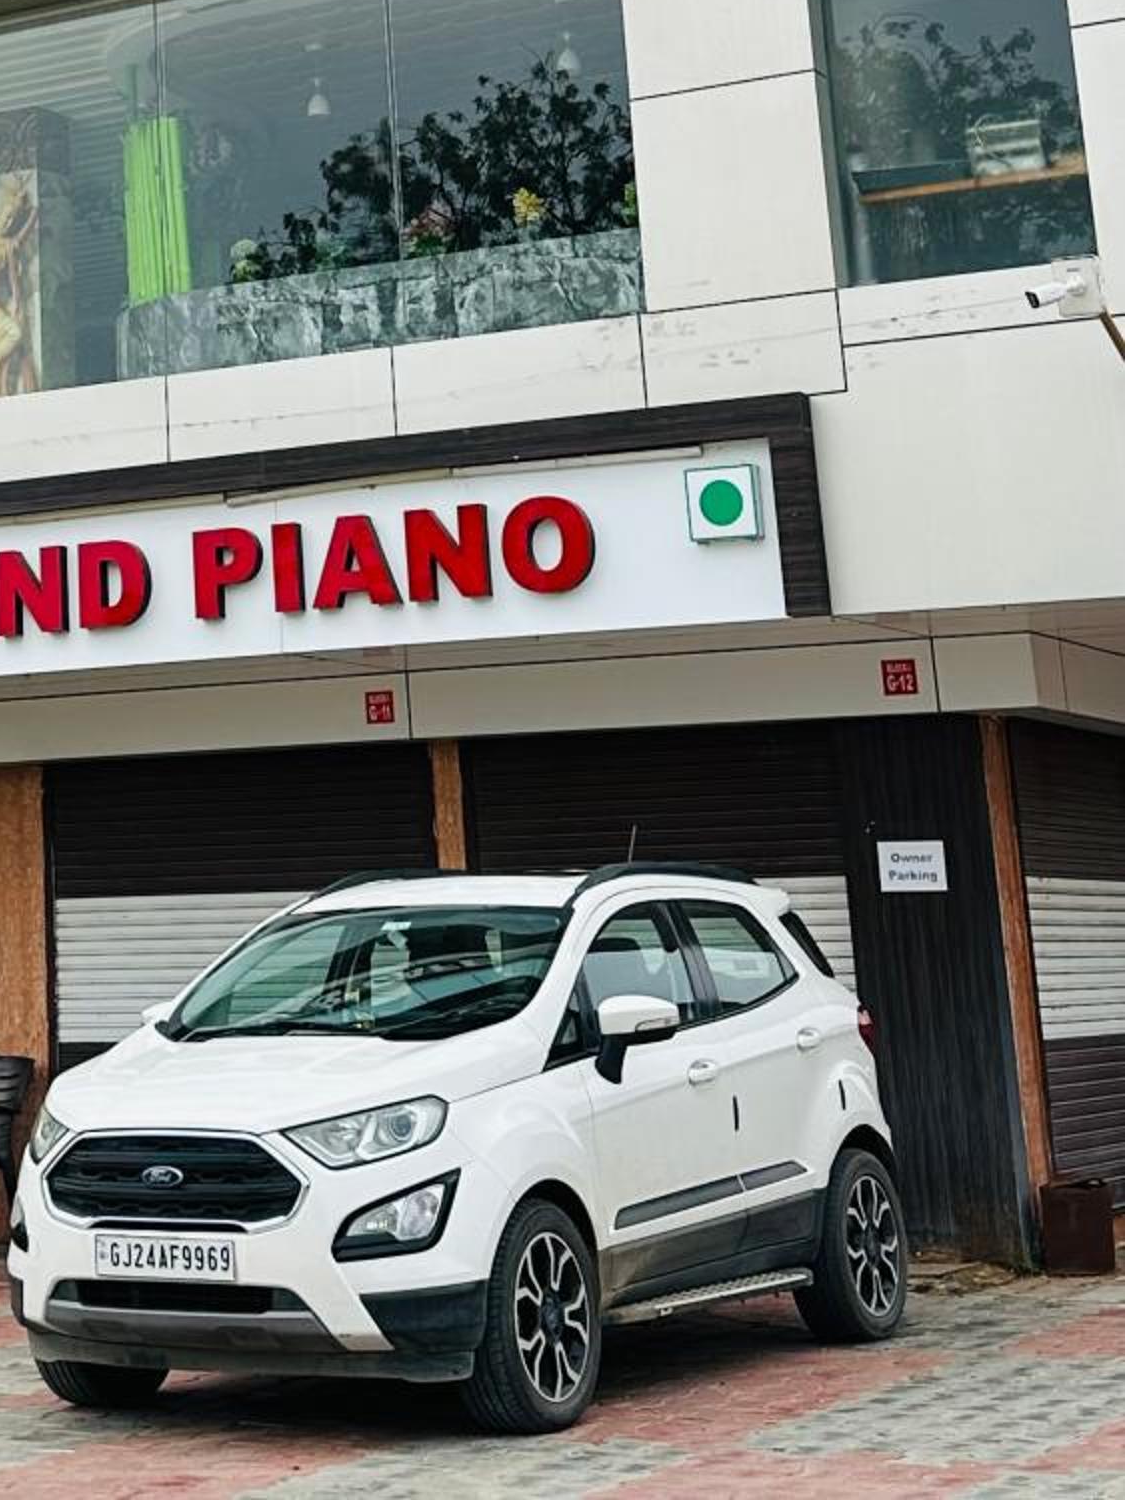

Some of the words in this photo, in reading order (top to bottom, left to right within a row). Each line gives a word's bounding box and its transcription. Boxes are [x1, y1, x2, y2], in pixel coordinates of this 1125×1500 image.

[192, 495, 596, 620] PIANO
[890, 853, 933, 863] Owner
[888, 870, 938, 883] Parking
[110, 1242, 230, 1271] GJ24AF9969
